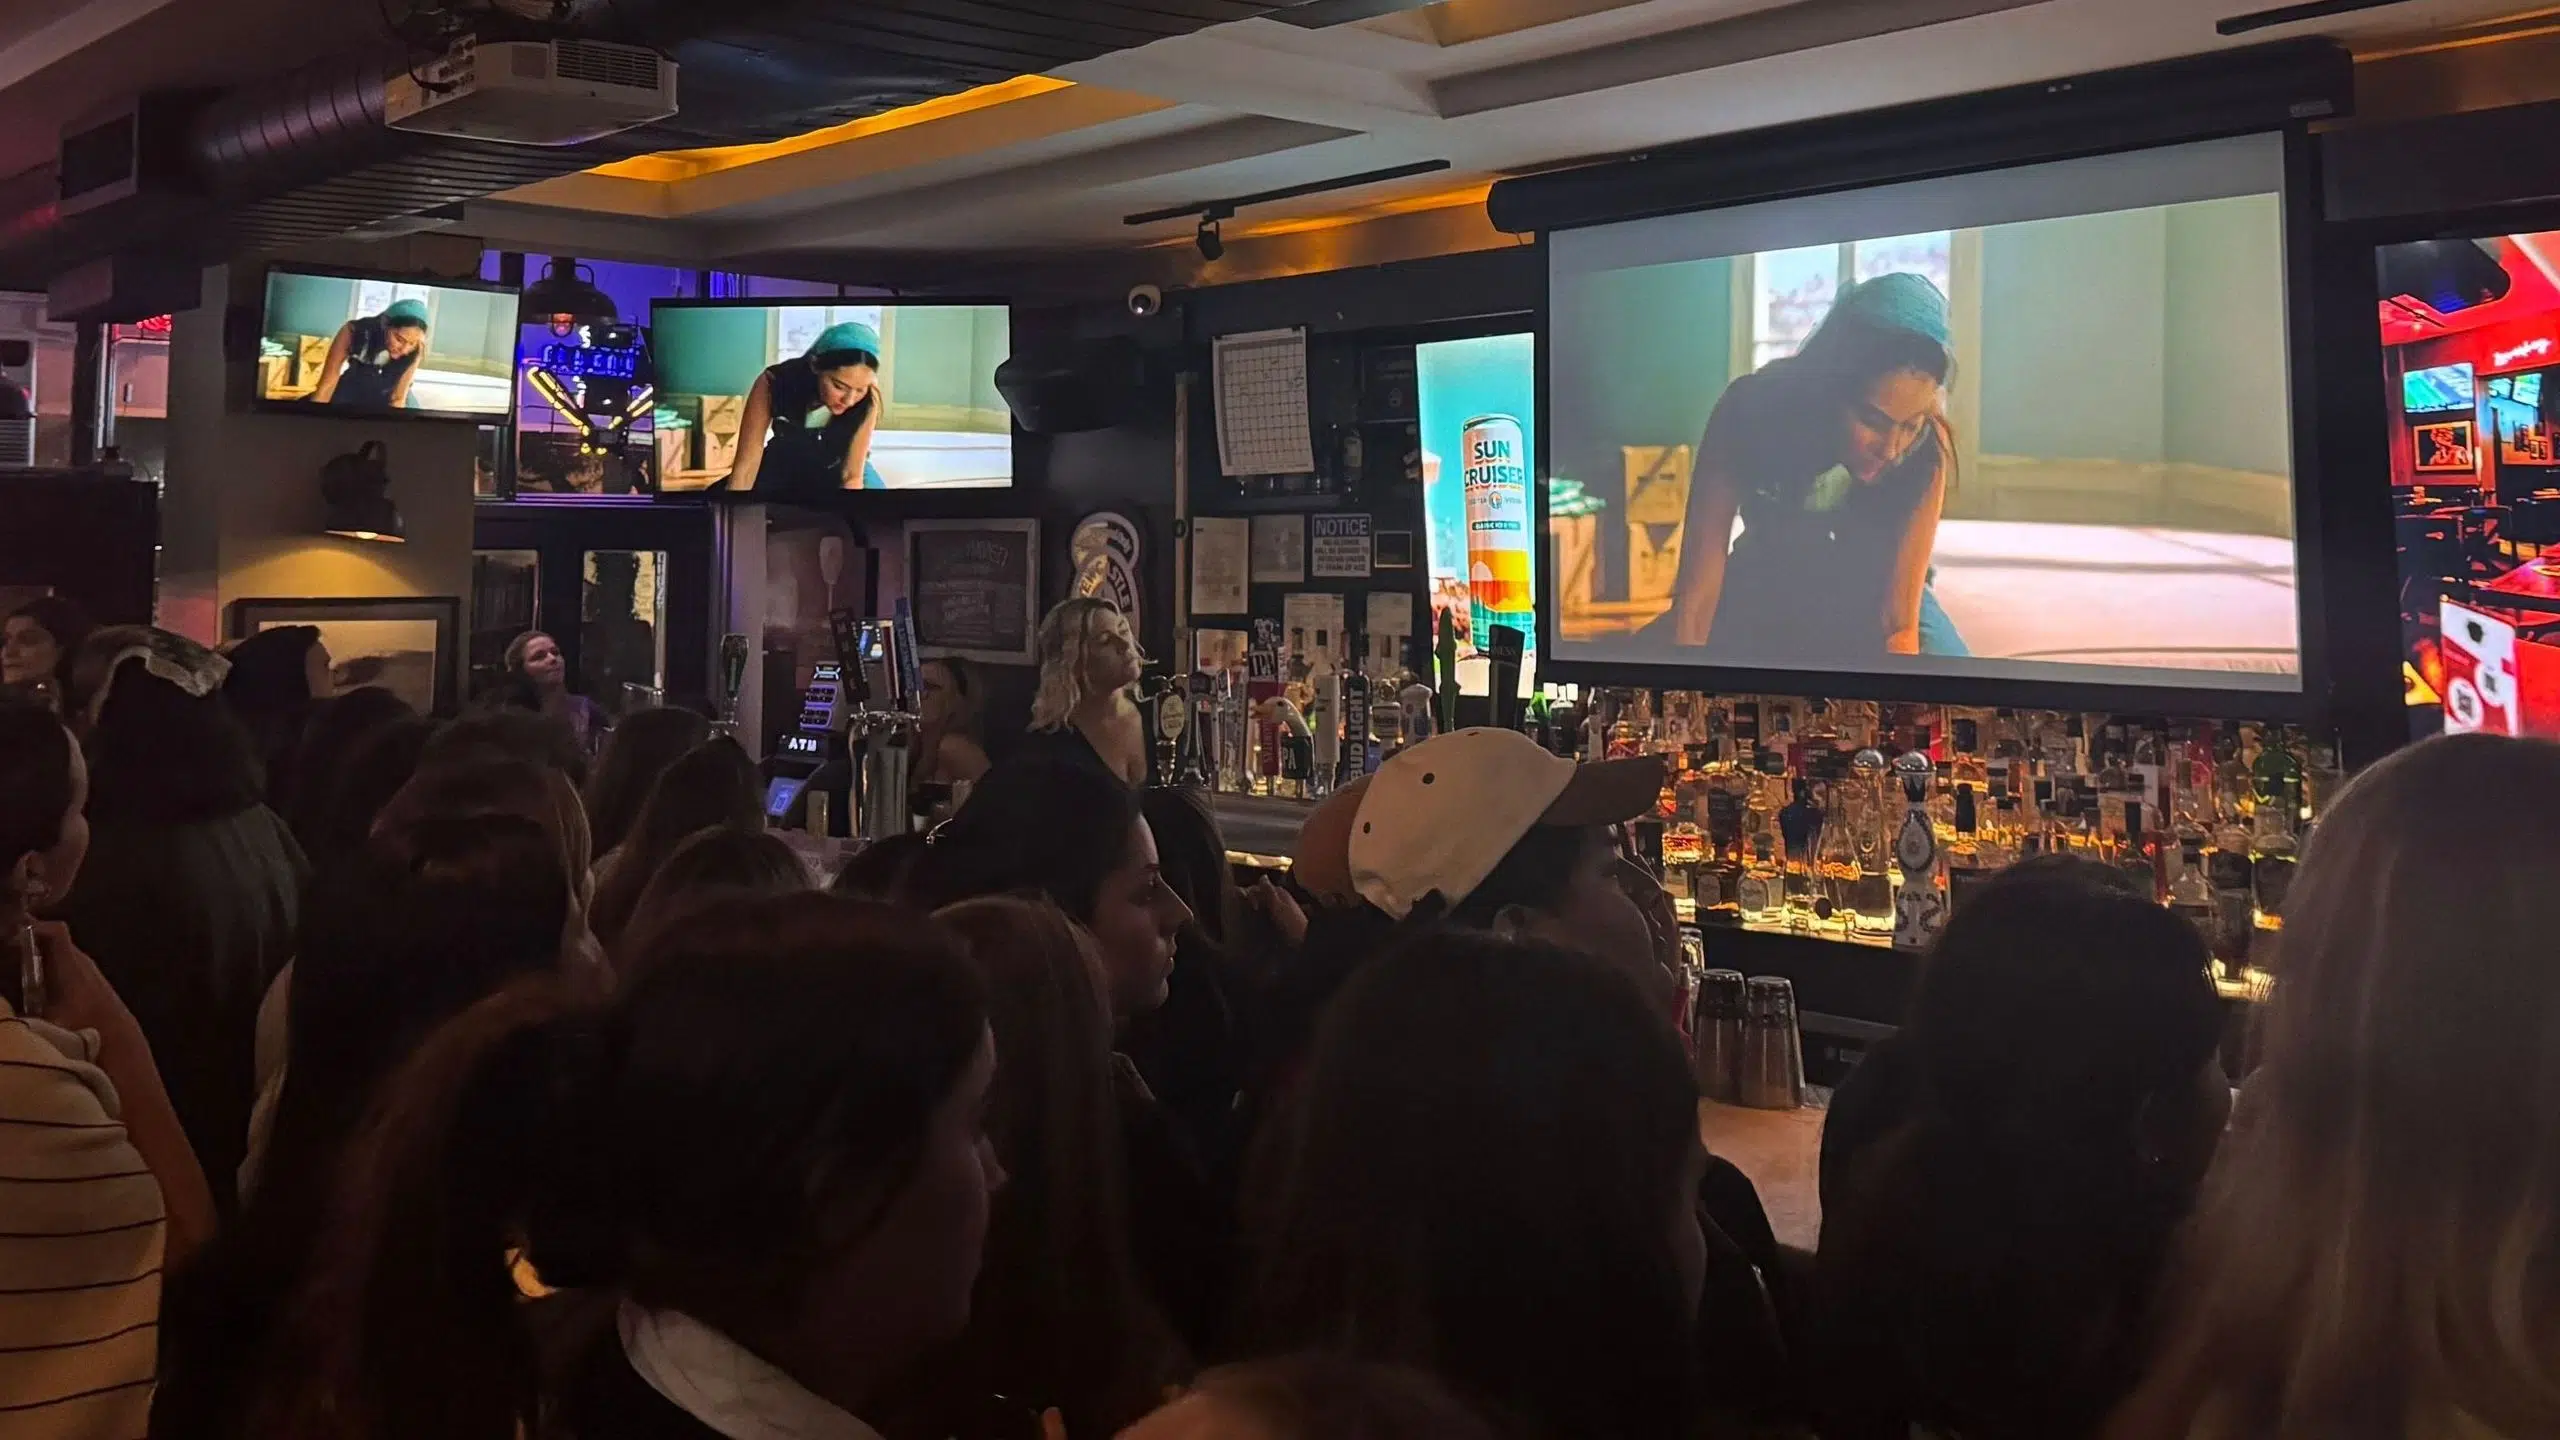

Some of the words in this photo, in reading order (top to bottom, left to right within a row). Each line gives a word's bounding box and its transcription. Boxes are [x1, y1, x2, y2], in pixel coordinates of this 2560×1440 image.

[1474, 440, 1510, 459] SUN
[1464, 465, 1523, 487] CRUISER
[1315, 518, 1368, 537] NOTICE
[1350, 687, 1364, 741] LIGHT
[788, 737, 817, 752] ATM
